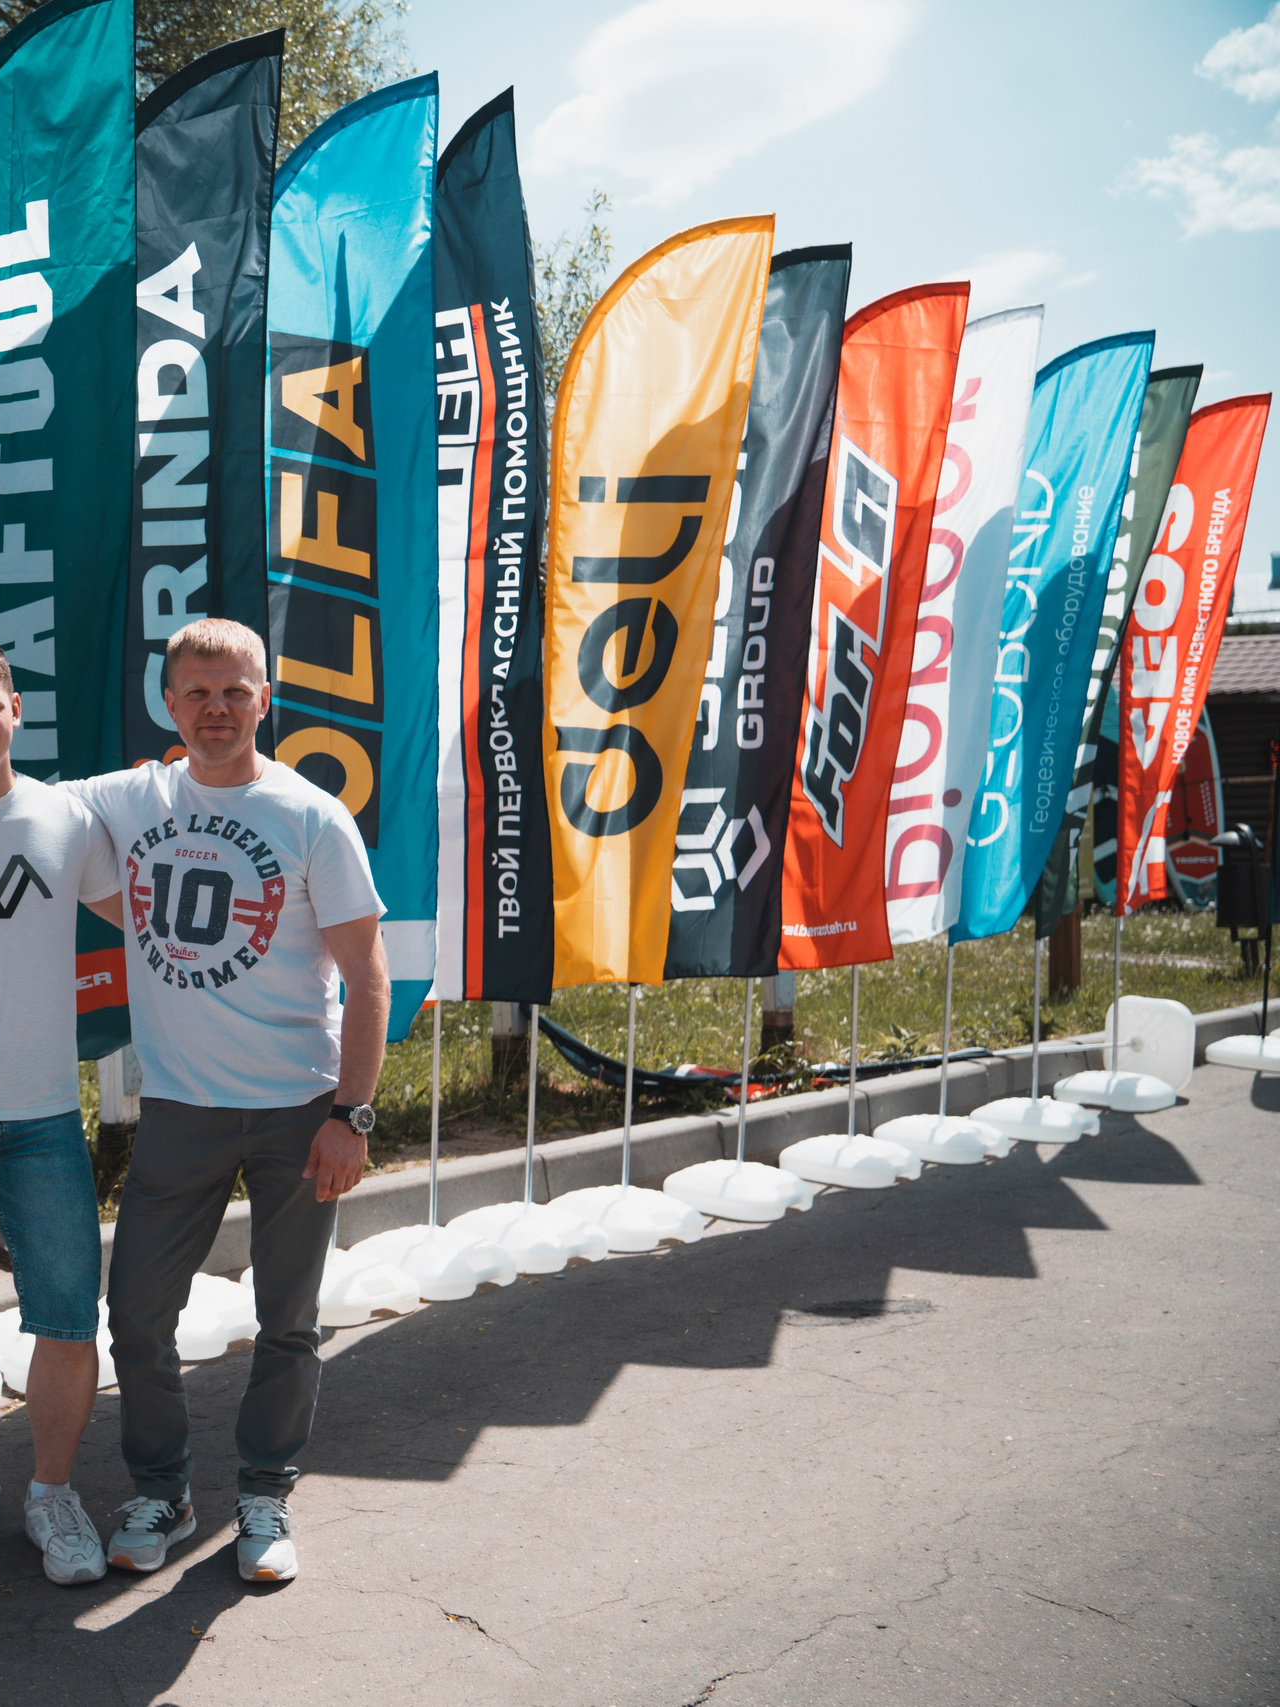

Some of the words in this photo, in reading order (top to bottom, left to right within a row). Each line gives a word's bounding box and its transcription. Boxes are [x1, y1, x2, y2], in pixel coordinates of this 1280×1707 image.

[490, 297, 529, 520] ПОМОЩНИК
[1206, 488, 1231, 556] БРЕНДА
[275, 356, 374, 817] OLFA
[1188, 559, 1218, 662] ИЗВЕСТНОГО
[488, 531, 524, 838] ПЕРВОКЛАССНЫЙ
[560, 475, 711, 837] deli
[736, 557, 775, 750] GROUP
[966, 469, 1054, 847] GEOBOND
[1029, 661, 1065, 833] Геодезическое
[1059, 485, 1095, 656] оборудование
[1180, 668, 1196, 705] ИМЯ
[1172, 708, 1193, 766] НОВОЕ
[130, 817, 178, 860] THE
[187, 814, 282, 880] LEGEND
[175, 848, 218, 861] SOCCER
[492, 847, 521, 938] ТВОЙ
[150, 863, 234, 946] 10
[137, 930, 258, 989] AWESOME
[165, 942, 200, 960] Striker
